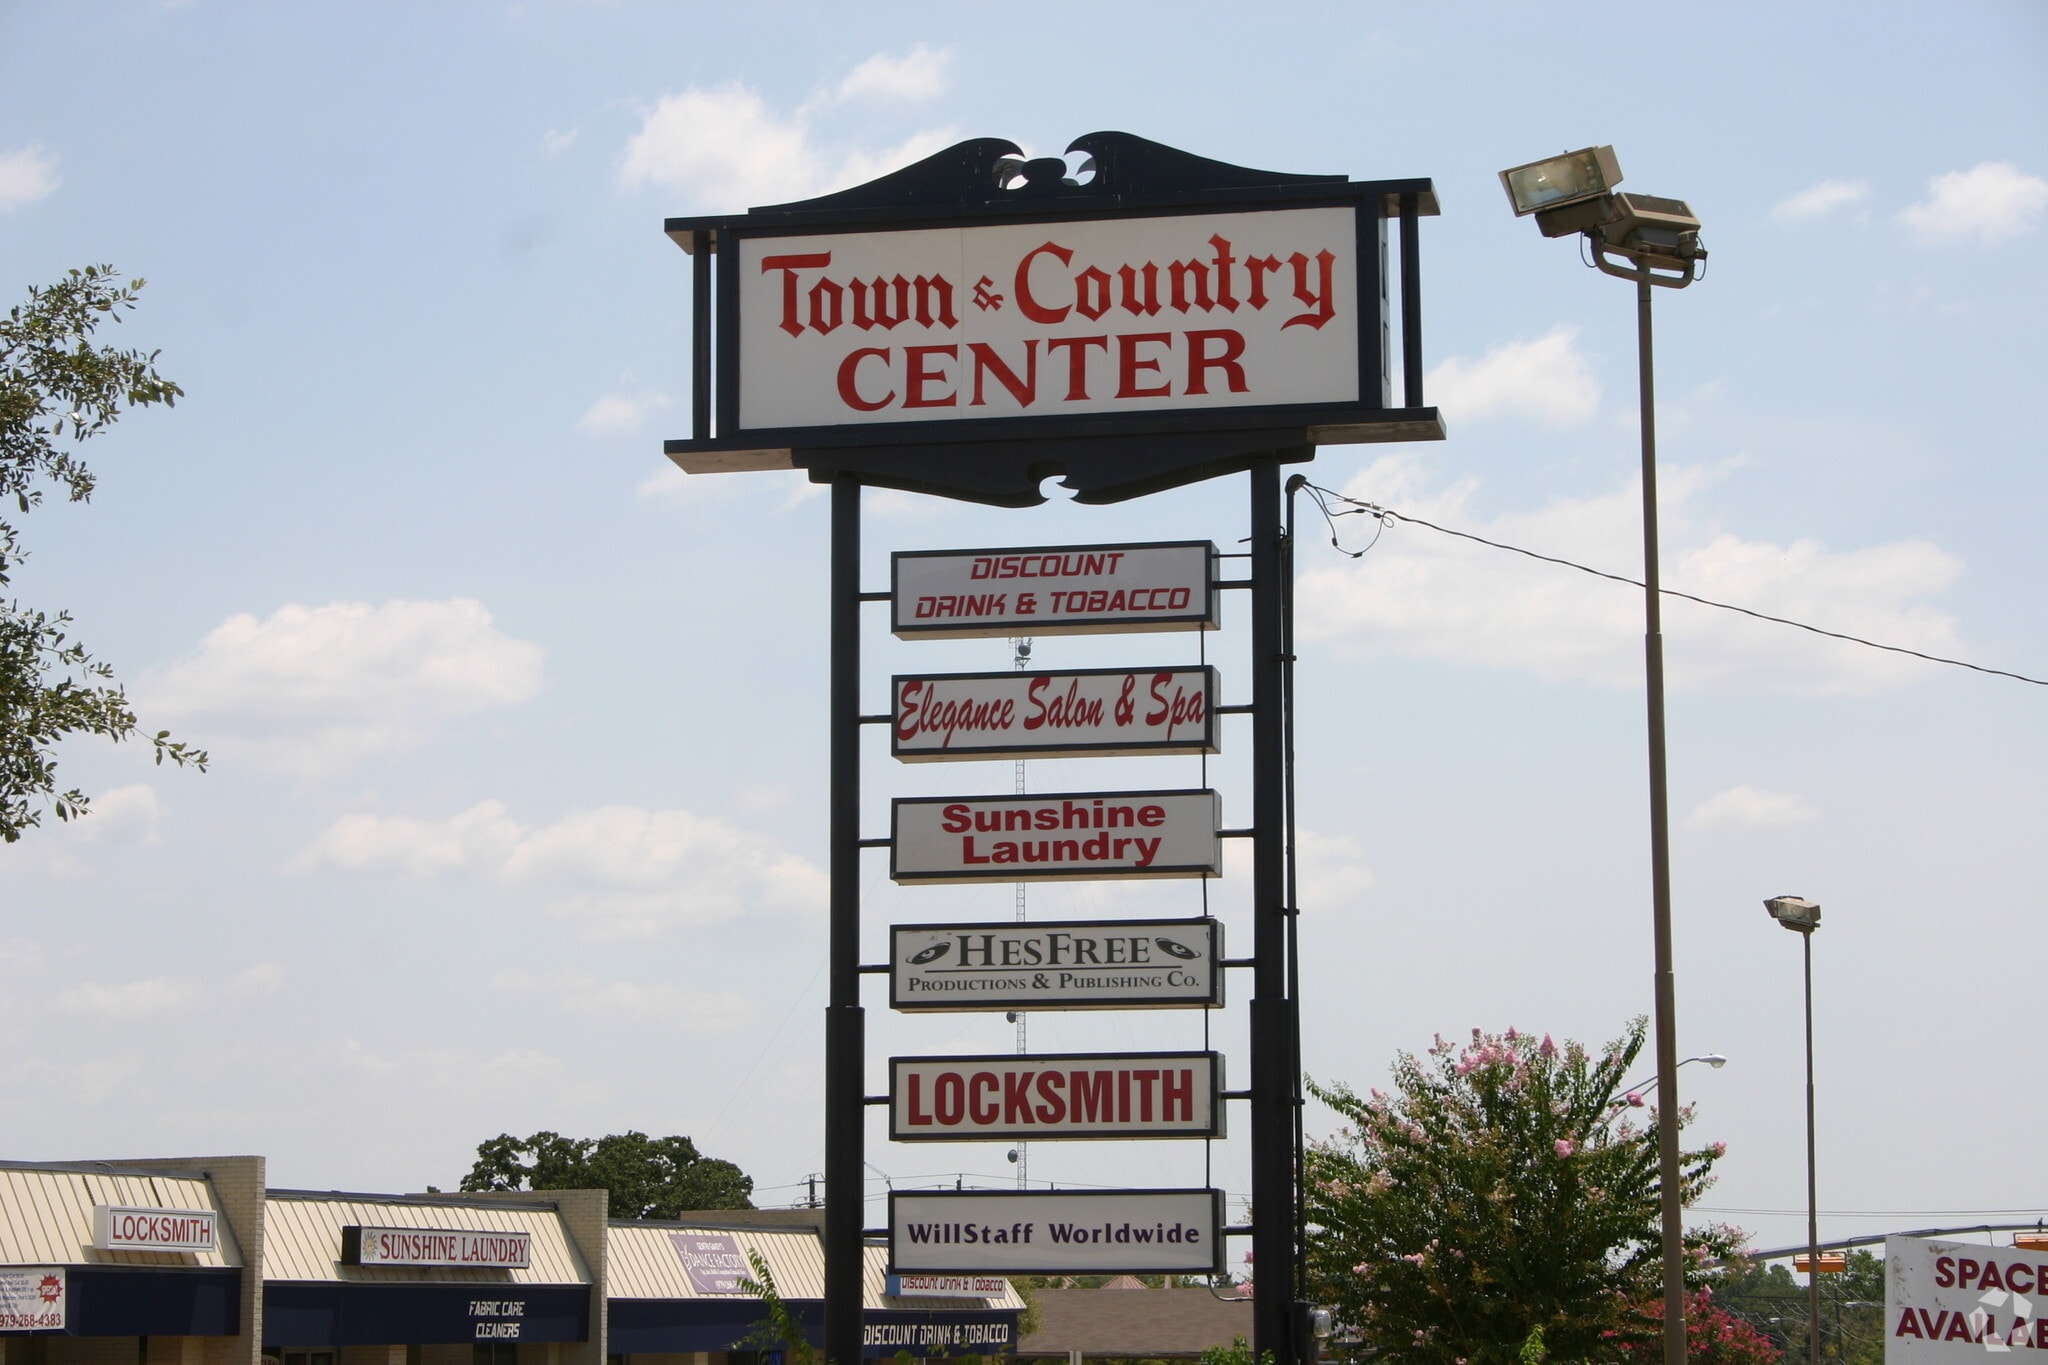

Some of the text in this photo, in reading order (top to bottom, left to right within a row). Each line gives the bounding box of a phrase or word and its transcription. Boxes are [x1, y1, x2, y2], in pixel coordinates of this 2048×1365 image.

[761, 233, 1337, 338] Town & Country
[836, 328, 1252, 412] CENTER
[970, 552, 1124, 580] DISCOUNT
[915, 587, 1191, 619] DRINK & TOBACCO
[897, 672, 1205, 748] Elegance Salon & Spa
[941, 800, 1166, 833] Sunshine
[963, 831, 1162, 867] Laundry
[1032, 972, 1050, 990] &
[908, 1069, 1193, 1126] LOCKSMITH
[112, 1215, 211, 1243] LOCKSMITH
[907, 1222, 1200, 1244] WillStaff Worldwide
[379, 1234, 527, 1262] SUNSHINE LAUNDRY
[469, 1301, 525, 1316] FABRIC CARE
[475, 1323, 520, 1338] CLEANERS
[863, 1323, 1009, 1346] DISCOUNT DRINK & TOBACCO
